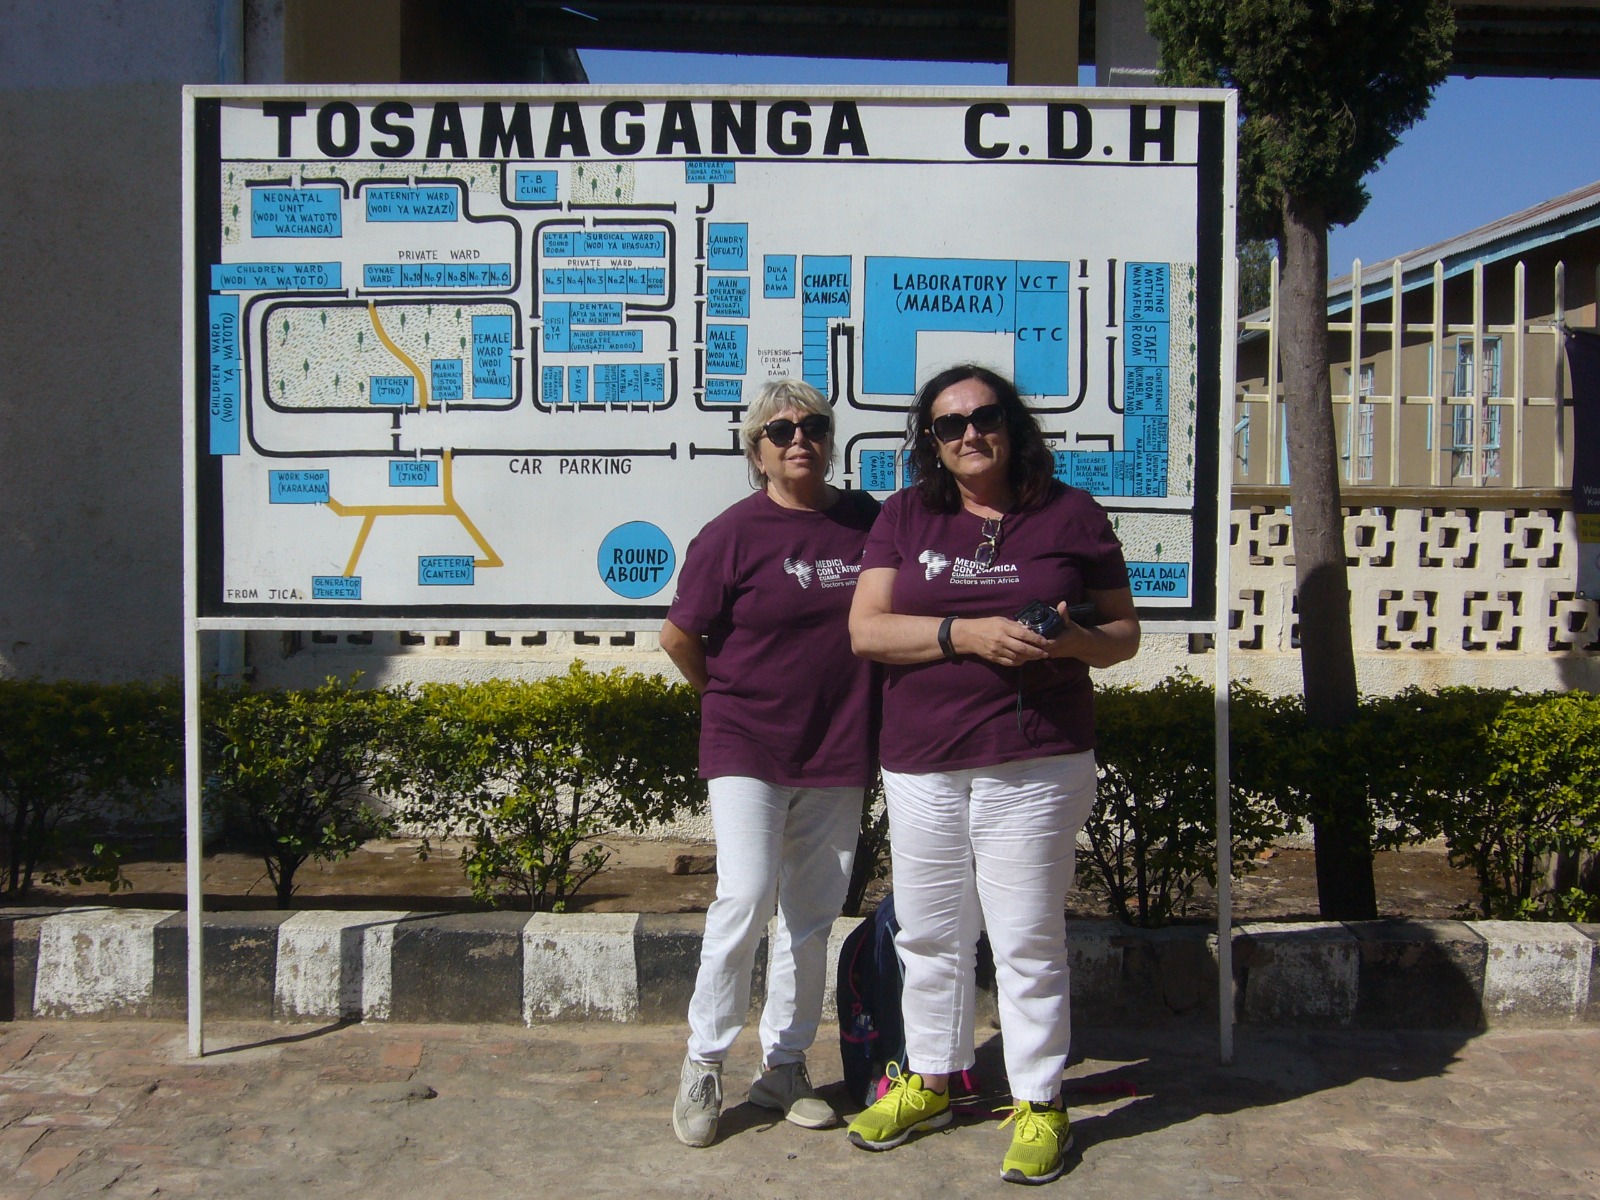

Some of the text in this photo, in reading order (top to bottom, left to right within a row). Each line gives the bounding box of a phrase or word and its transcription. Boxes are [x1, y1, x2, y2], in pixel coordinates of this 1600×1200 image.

[262, 101, 869, 158] TOSAMAGANGA
[263, 192, 323, 203] NEONATAL
[369, 191, 450, 201] MATERNITY WARD
[280, 204, 304, 213] UNIT
[367, 201, 455, 217] (WODI YA WAZAZI)
[253, 211, 338, 224] (WODI YA WATOTO
[275, 222, 333, 234] WACHANGA)
[586, 233, 625, 241] SURGICAL
[709, 236, 744, 244] LAUNDRY
[398, 250, 481, 260] PRIVATE WARD
[710, 244, 744, 258] (UFUAJI)
[567, 259, 633, 267] PRIVATE WARD
[236, 264, 324, 274] CHILDREN WARD
[367, 266, 396, 275] GYNAE
[220, 273, 329, 288] (WODI YA WATOTO)
[369, 275, 392, 283] WARD
[775, 274, 787, 282] LA
[803, 274, 849, 288] CHAPEL
[893, 273, 1008, 291] LABORATORY
[1144, 269, 1153, 312] MOTHER
[1156, 267, 1164, 313] WAITING
[802, 289, 850, 306] (KANISA)
[896, 292, 1004, 317] (MAABARA)
[473, 332, 510, 344] FEMALE
[710, 330, 736, 341] MALE
[1132, 325, 1142, 357] ROOM
[714, 342, 738, 350] WARD
[1145, 326, 1157, 364] STAFF
[476, 347, 503, 357] WARD
[729, 352, 739, 360] YA
[219, 312, 236, 422] (WODI YA WATOTO)
[479, 358, 501, 369] (WODI
[211, 323, 220, 416] CHILDREN WARD
[486, 368, 497, 377] YA
[768, 369, 790, 377] DAWA)
[375, 378, 409, 386] KITCHEN
[377, 386, 405, 398] (JIKO)
[1126, 371, 1135, 415] MIKUTANO)
[1145, 376, 1153, 400] ROOM
[1136, 399, 1144, 411] WA
[395, 463, 430, 472] KITCHEN
[509, 458, 632, 475] CAR PARKING
[870, 456, 879, 488] (MALIPO)
[278, 473, 300, 481] WORK
[398, 472, 427, 483] (JIKO)
[278, 482, 329, 496] (KARAKANA)
[613, 548, 669, 566] ROUND
[421, 558, 471, 568] CAFETERIA
[815, 559, 843, 568] MEDICI
[422, 568, 470, 582] (CANTEEN)
[604, 566, 664, 583] ABOUT
[816, 567, 834, 576] CON
[953, 565, 972, 574] CON
[1160, 568, 1186, 579] DALA
[314, 578, 360, 588] GENERATOR
[1133, 580, 1176, 592] STAND
[226, 588, 258, 599] FROM
